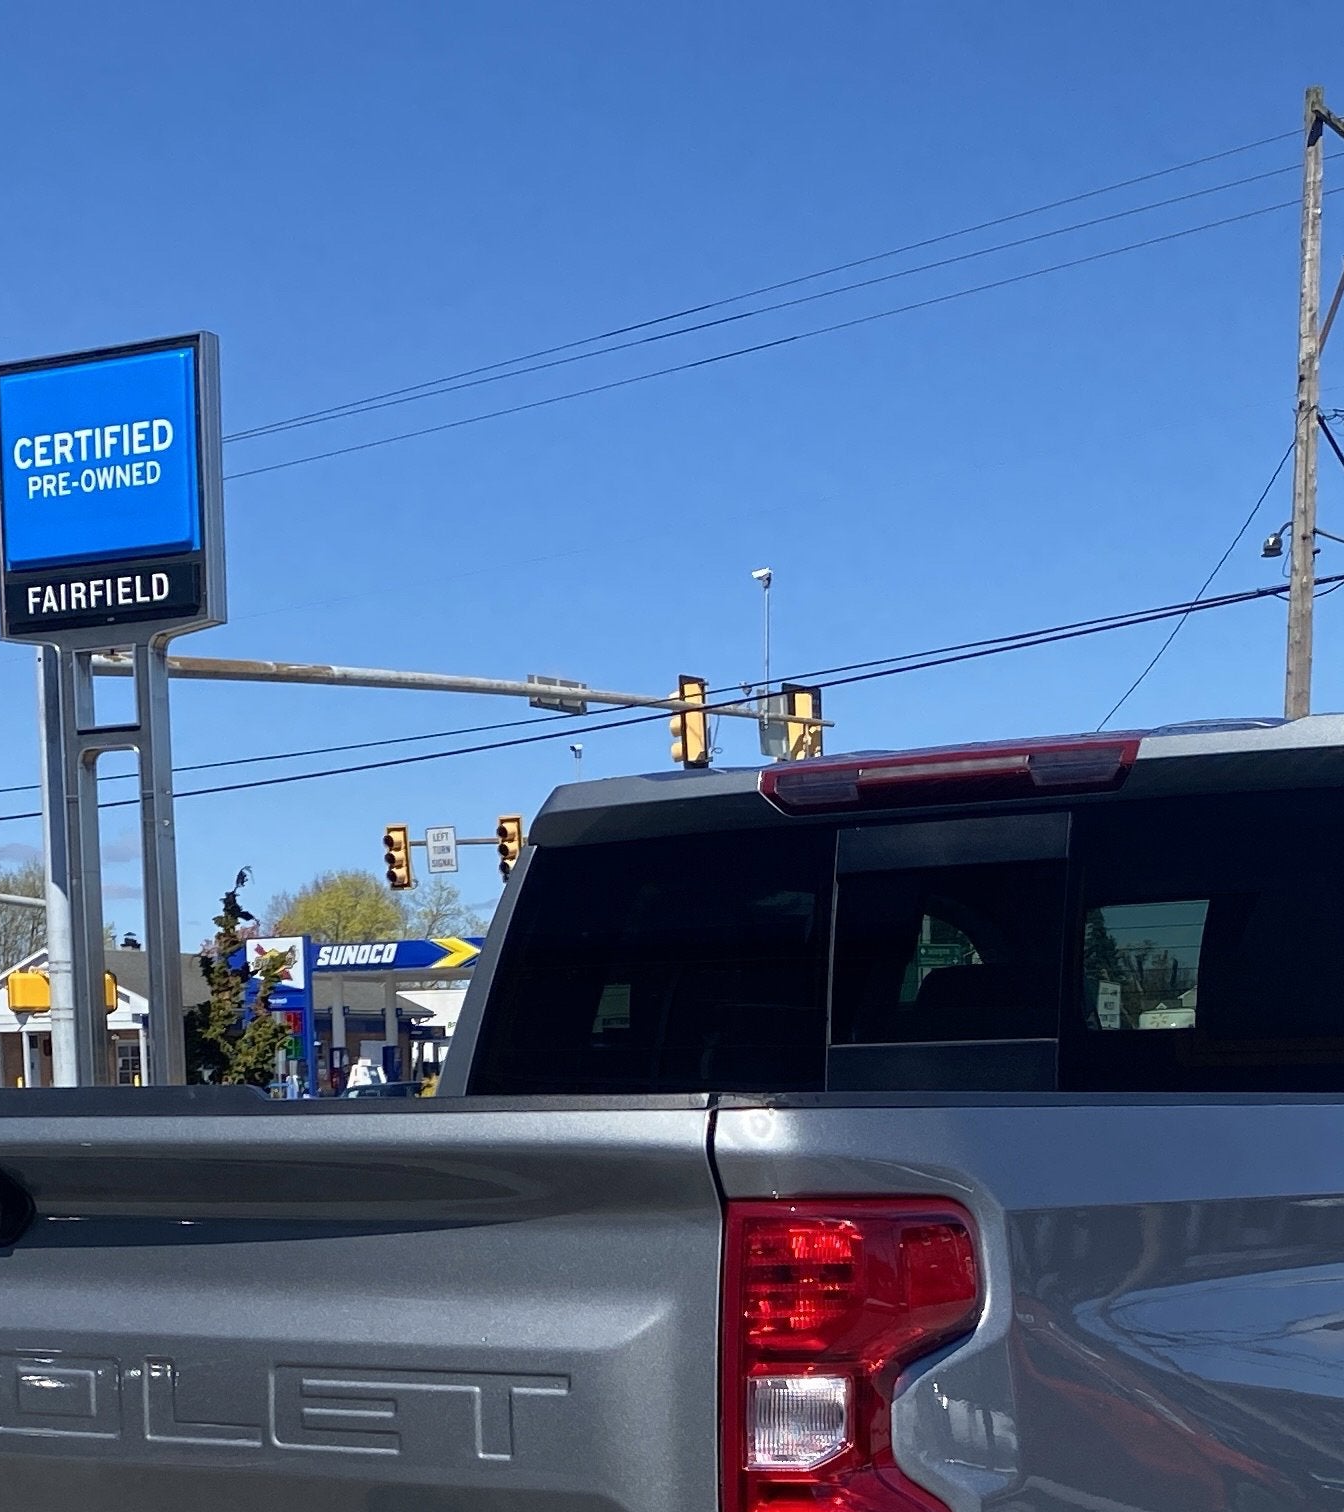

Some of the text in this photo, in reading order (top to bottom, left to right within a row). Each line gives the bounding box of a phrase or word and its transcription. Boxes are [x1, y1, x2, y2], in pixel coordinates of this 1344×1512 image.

[13, 418, 174, 470] CERTIFIED
[28, 460, 162, 500] PRE-OWNED
[27, 572, 170, 615] FAIRFIELD
[432, 831, 449, 842] LEFT
[432, 845, 451, 855] TURN
[431, 859, 456, 868] SIGNAL
[316, 943, 398, 967] SUNOCO
